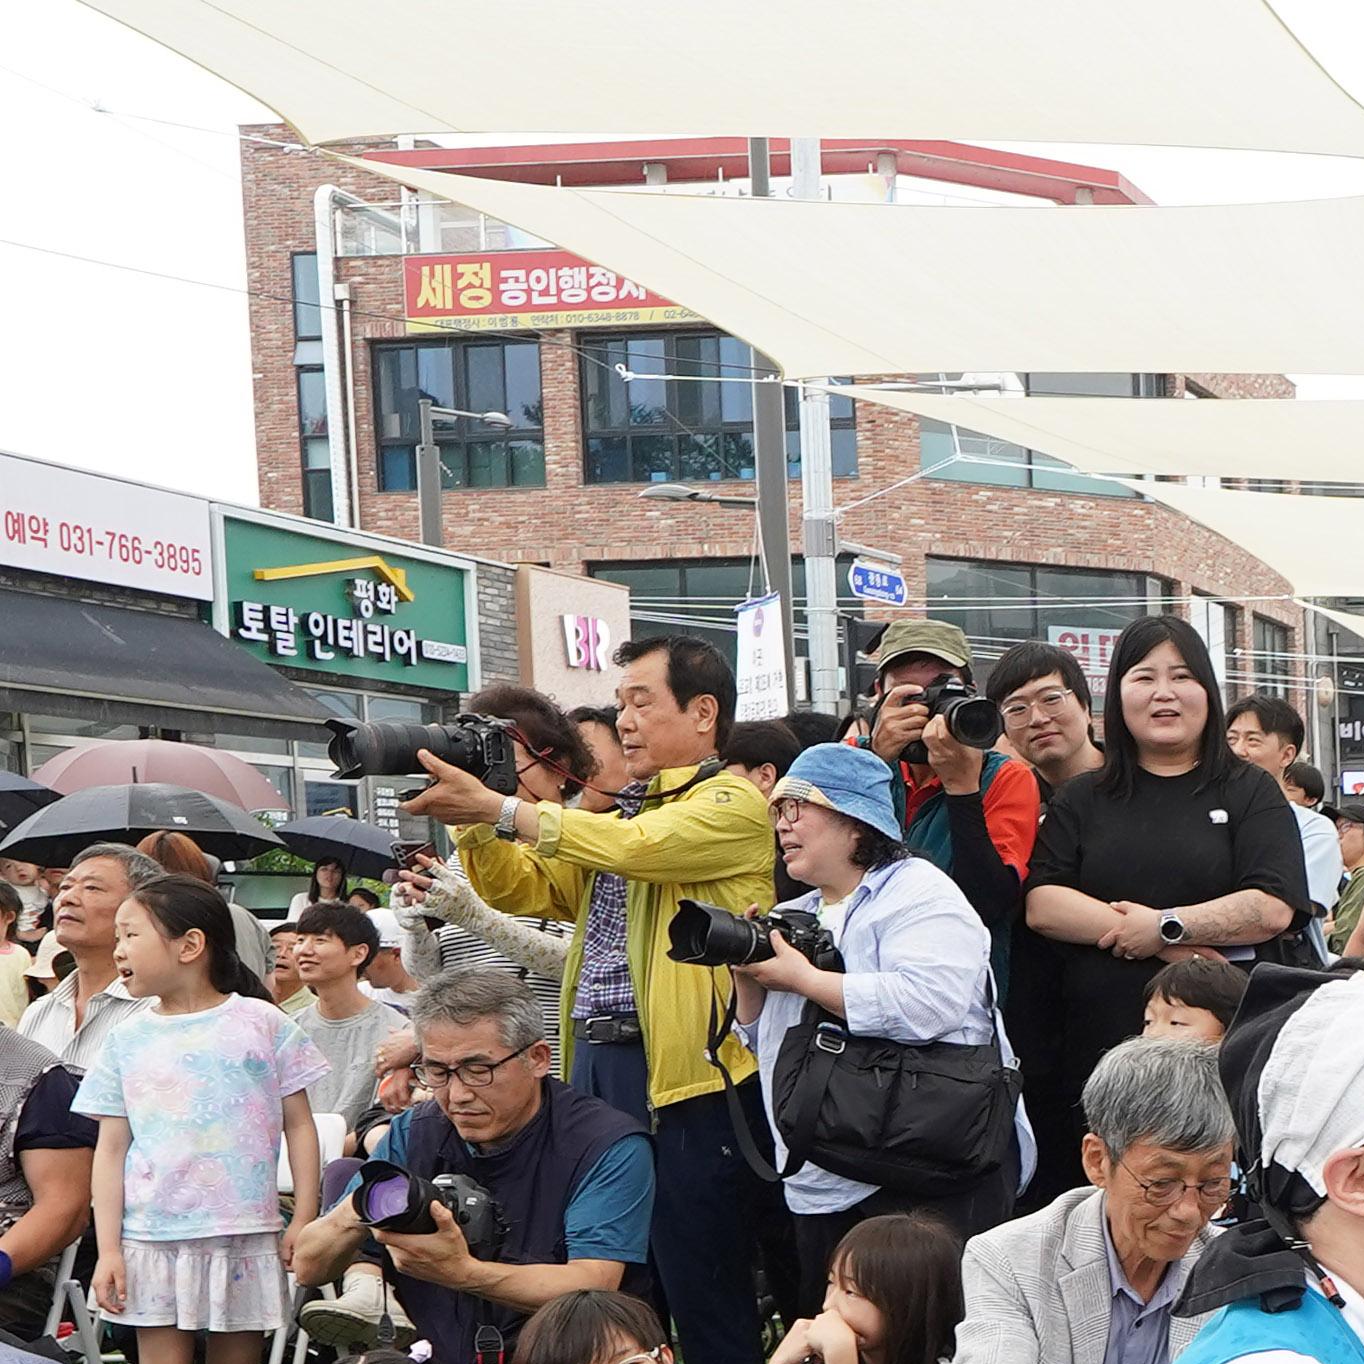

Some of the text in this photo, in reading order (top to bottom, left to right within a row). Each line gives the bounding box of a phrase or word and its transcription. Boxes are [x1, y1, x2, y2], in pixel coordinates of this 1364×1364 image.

[416, 262, 494, 310] 세정
[5, 510, 202, 576] 예약 031-766-3895
[353, 578, 398, 618] 평화
[238, 600, 299, 657] 토탈
[307, 611, 417, 666] 인테리어
